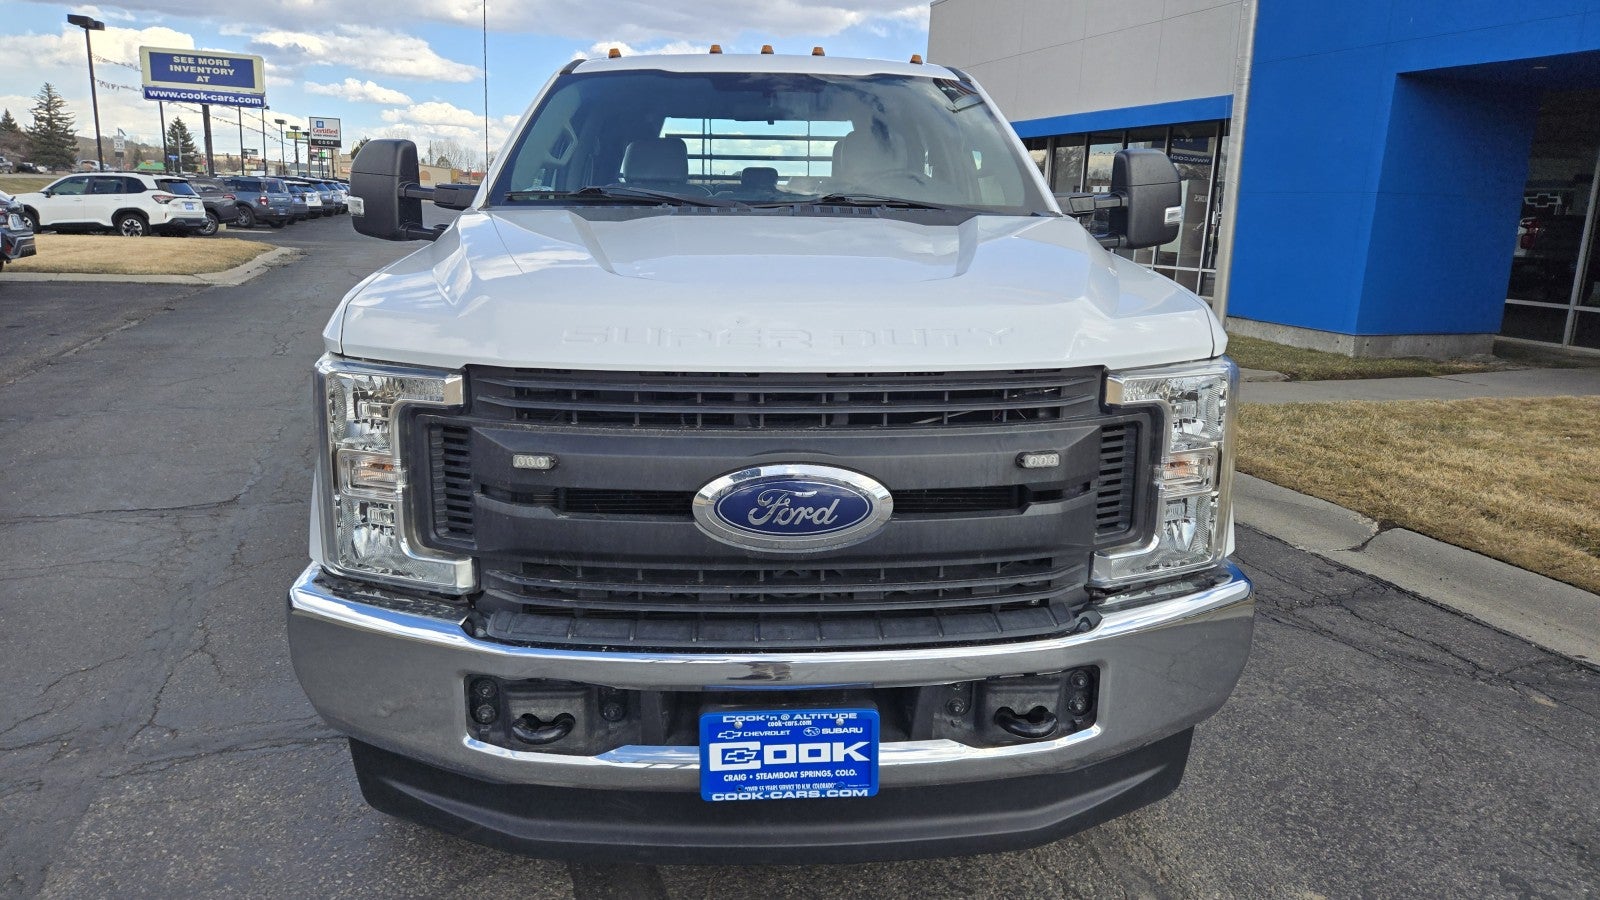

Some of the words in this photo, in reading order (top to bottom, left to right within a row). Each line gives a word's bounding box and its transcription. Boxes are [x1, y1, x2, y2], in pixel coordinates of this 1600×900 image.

[173, 55, 195, 64] SEE
[198, 57, 231, 67] MORE
[169, 64, 235, 76] INVENTORY
[196, 75, 210, 83] AT
[148, 90, 262, 105] www.cook-cars.com
[560, 326, 813, 349] SUPER
[832, 325, 1015, 348] DUTY
[747, 488, 840, 527] Ford
[793, 712, 858, 720] ALTITUDE
[743, 729, 791, 737] CHEVROLET
[821, 727, 863, 735] SUBARU
[709, 741, 871, 772] COOK
[723, 773, 747, 782] CRAIG
[755, 771, 799, 780] STEAMBOAT
[800, 770, 834, 778] SPRINGS,
[835, 769, 858, 777] COLO.
[711, 789, 869, 801] COOK-CARS.COM
